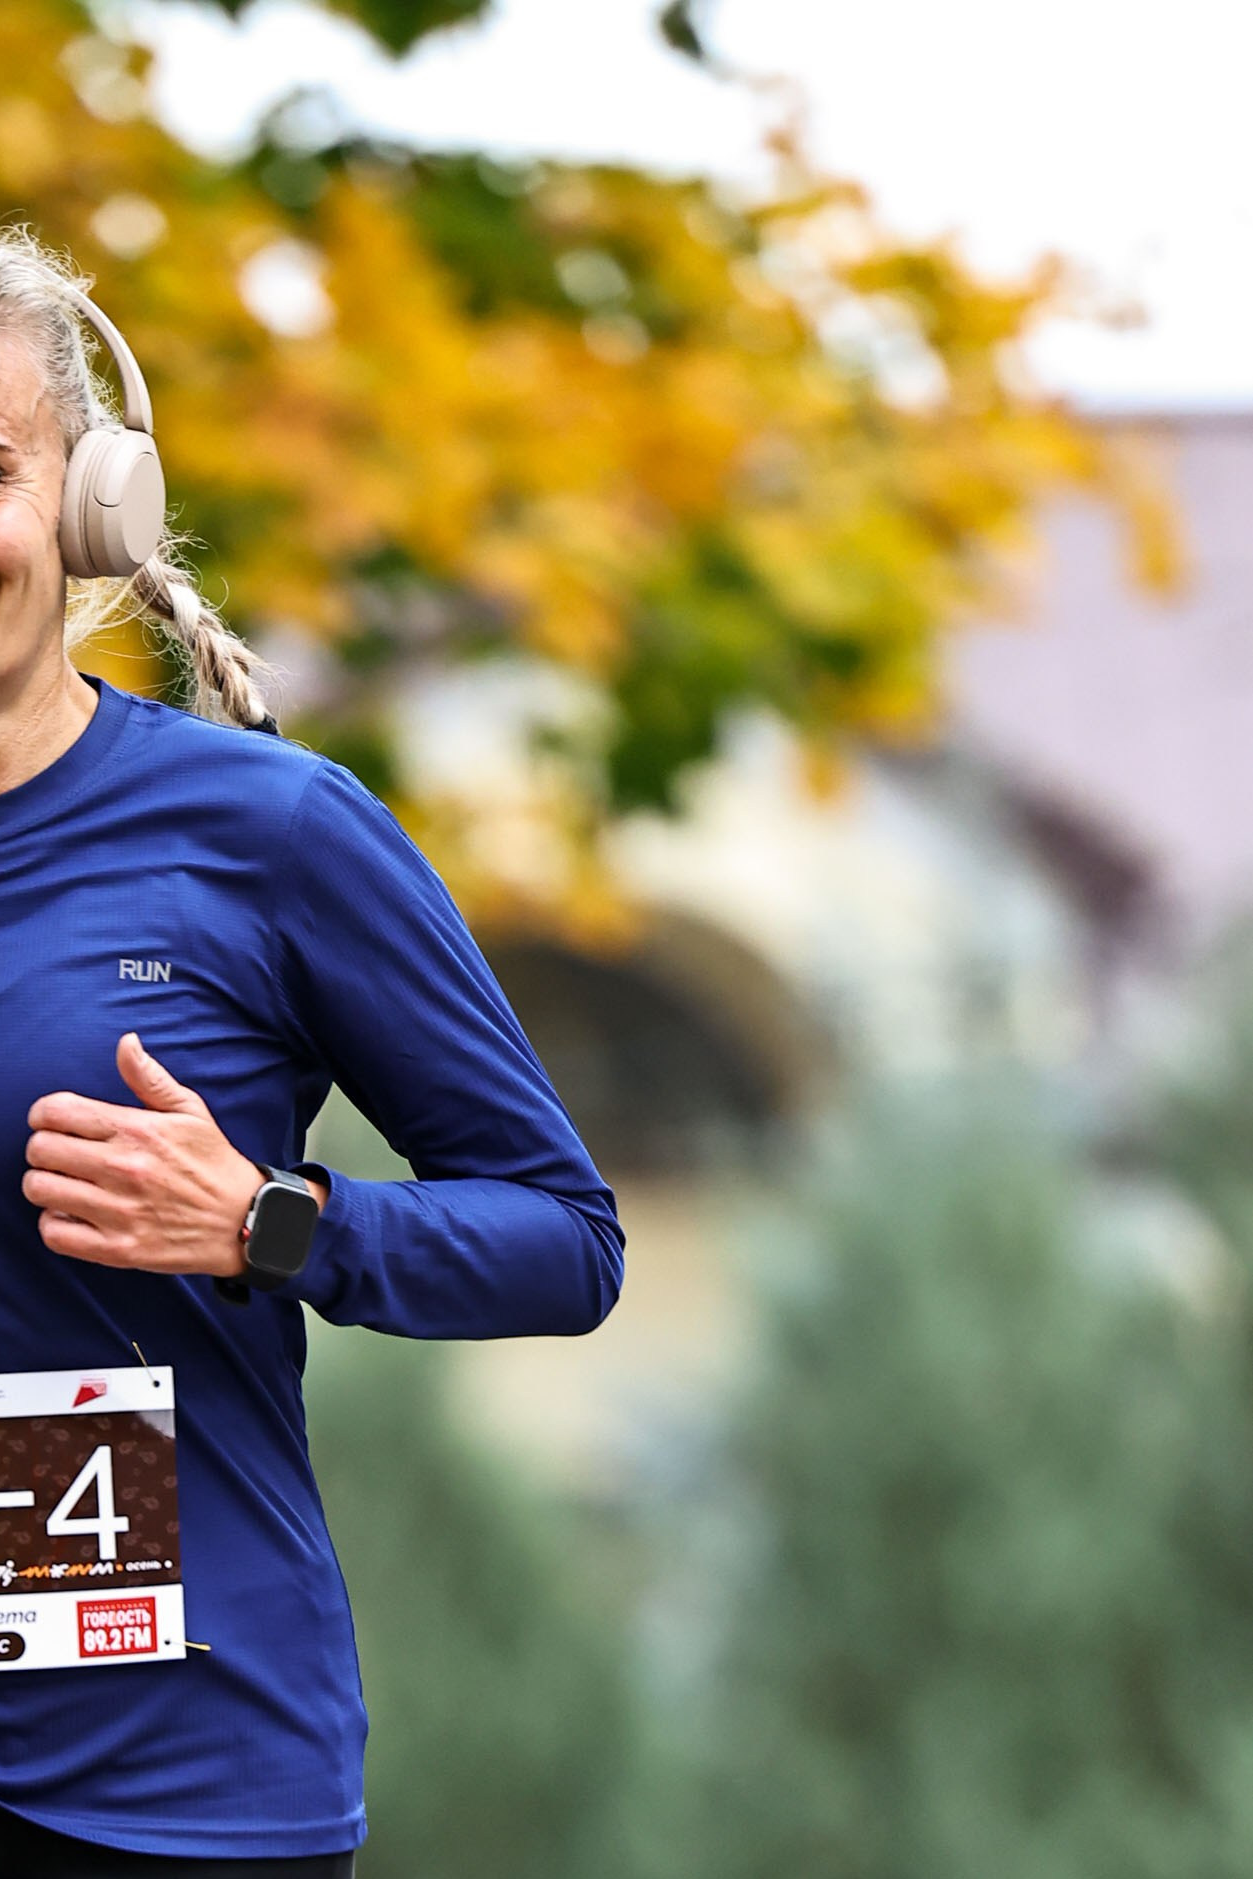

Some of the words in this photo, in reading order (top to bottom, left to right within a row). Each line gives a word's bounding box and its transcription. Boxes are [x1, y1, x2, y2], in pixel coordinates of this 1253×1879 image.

[119, 959, 171, 982] RUN
[83, 1627, 122, 1653] 89.2
[123, 1625, 152, 1650] FM
